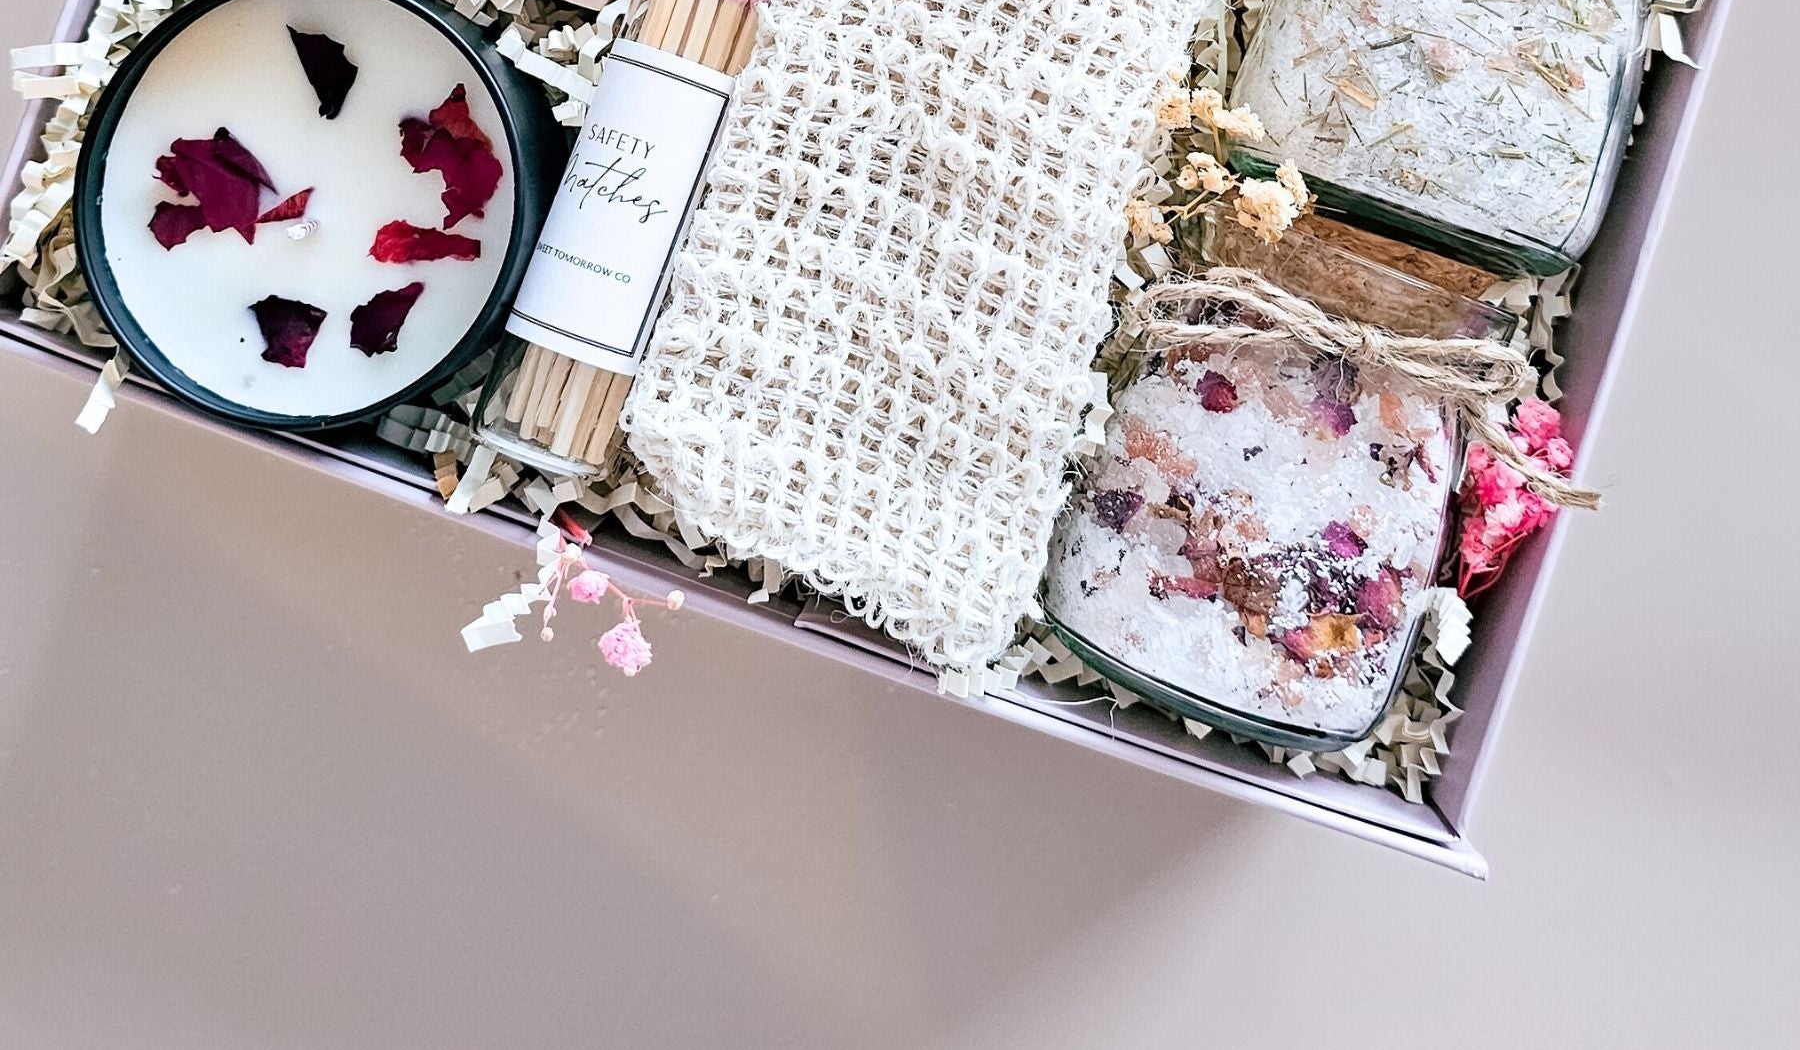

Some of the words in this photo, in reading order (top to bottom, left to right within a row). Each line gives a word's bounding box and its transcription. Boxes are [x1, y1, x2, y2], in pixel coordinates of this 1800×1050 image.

[588, 124, 655, 158] SAFETY
[553, 248, 613, 277] TOMORROW
[614, 272, 631, 284] CO
